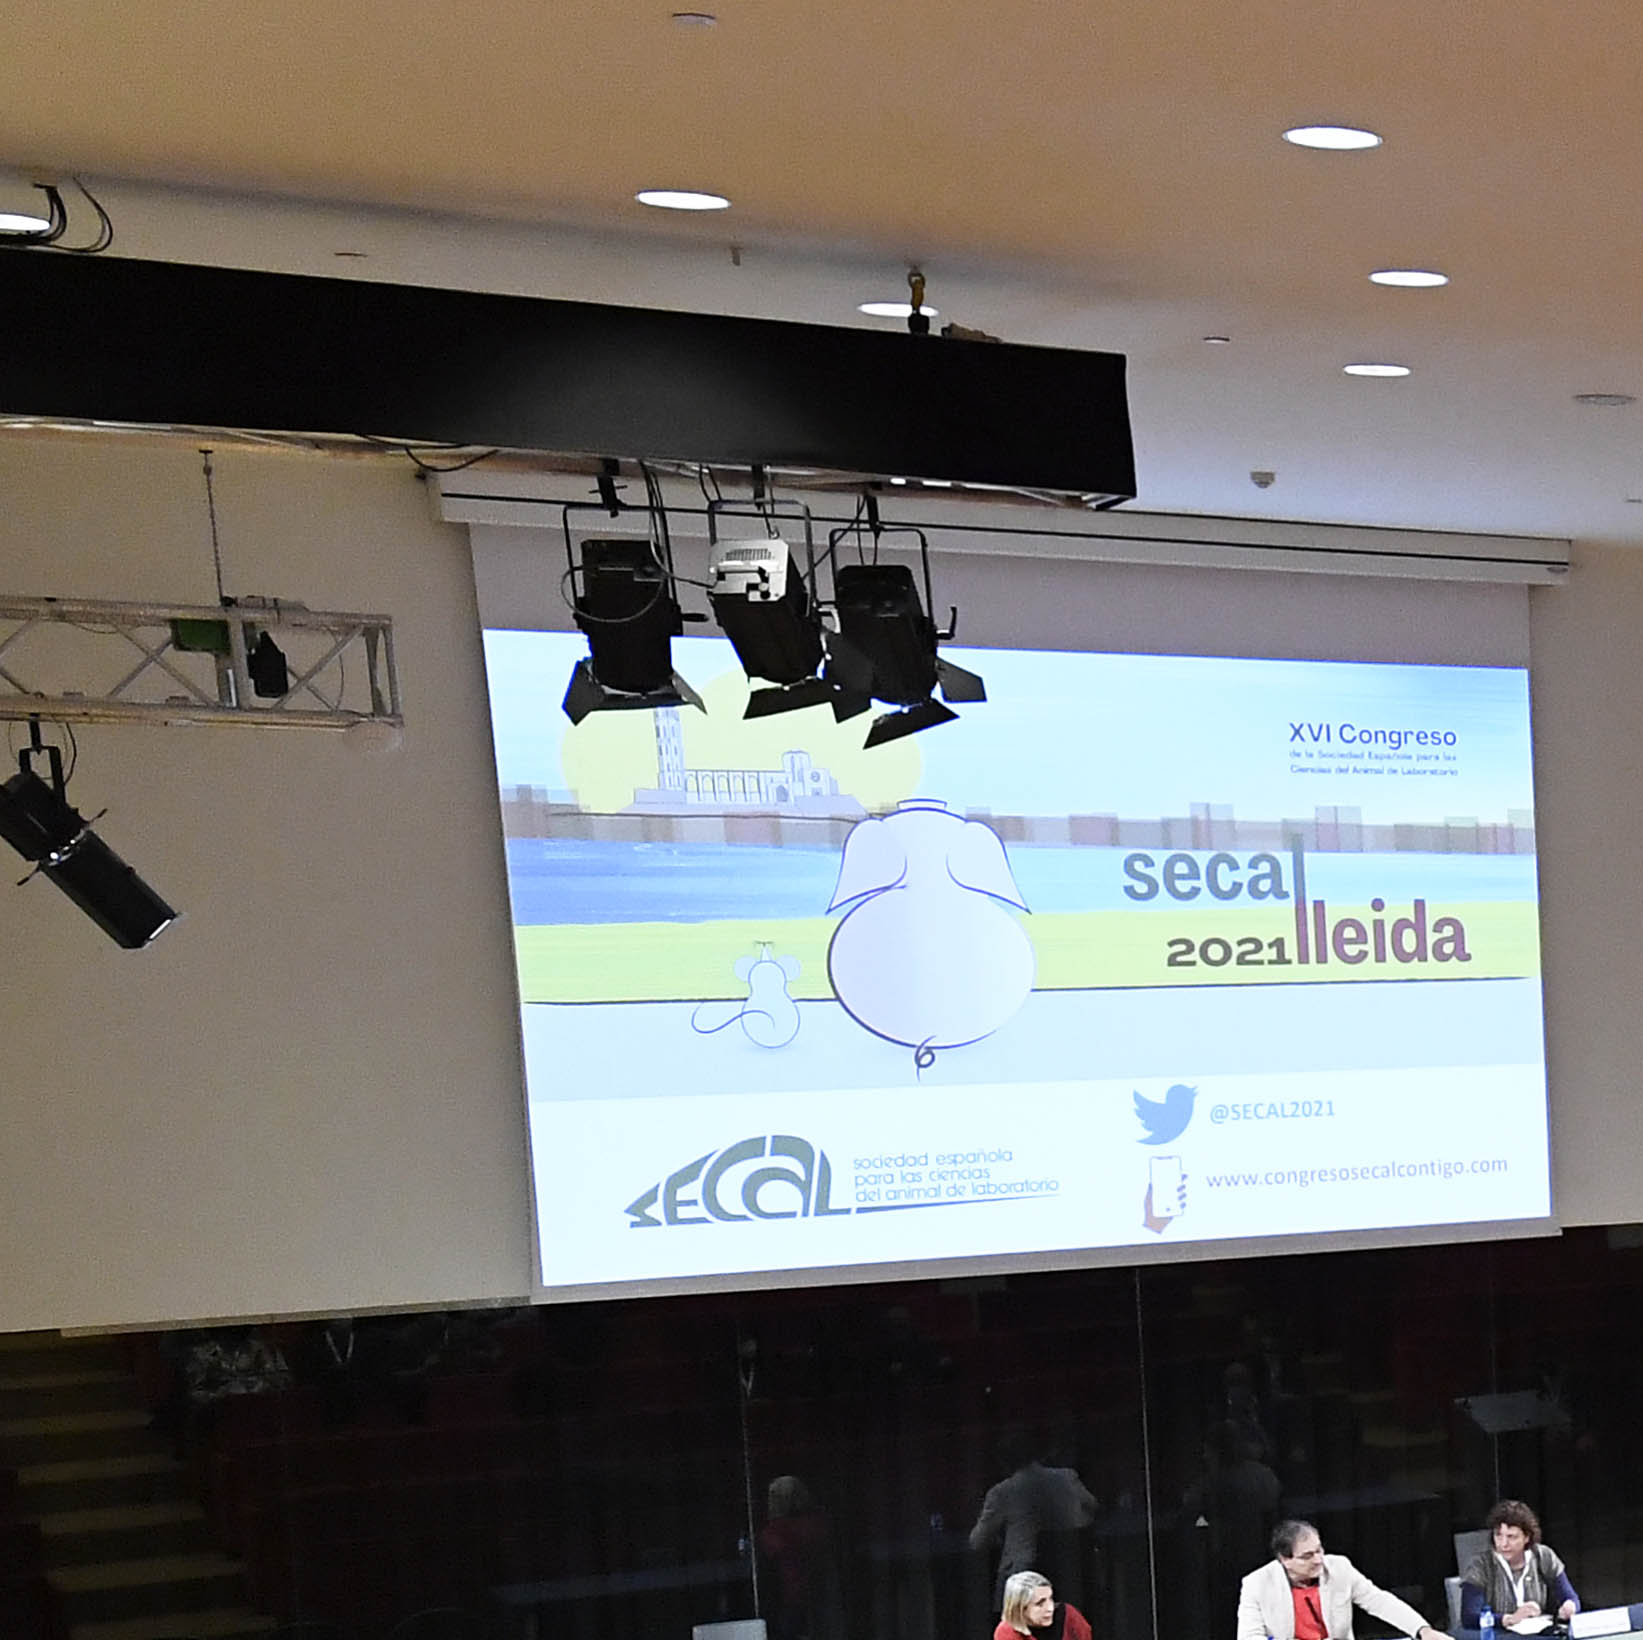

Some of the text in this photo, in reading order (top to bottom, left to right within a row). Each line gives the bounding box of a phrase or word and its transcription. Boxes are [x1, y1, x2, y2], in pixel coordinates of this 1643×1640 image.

[1289, 723, 1457, 750] XVI Congreso
[1167, 937, 1292, 967] 2021
[1209, 1100, 1336, 1125] @SECAL2021
[854, 1148, 1013, 1169] sociedad española
[855, 1166, 990, 1188] para las ciencias
[1207, 1158, 1508, 1188] www.congresosecalcontigo.com
[856, 1178, 1059, 1203] del animal de laboratorio
